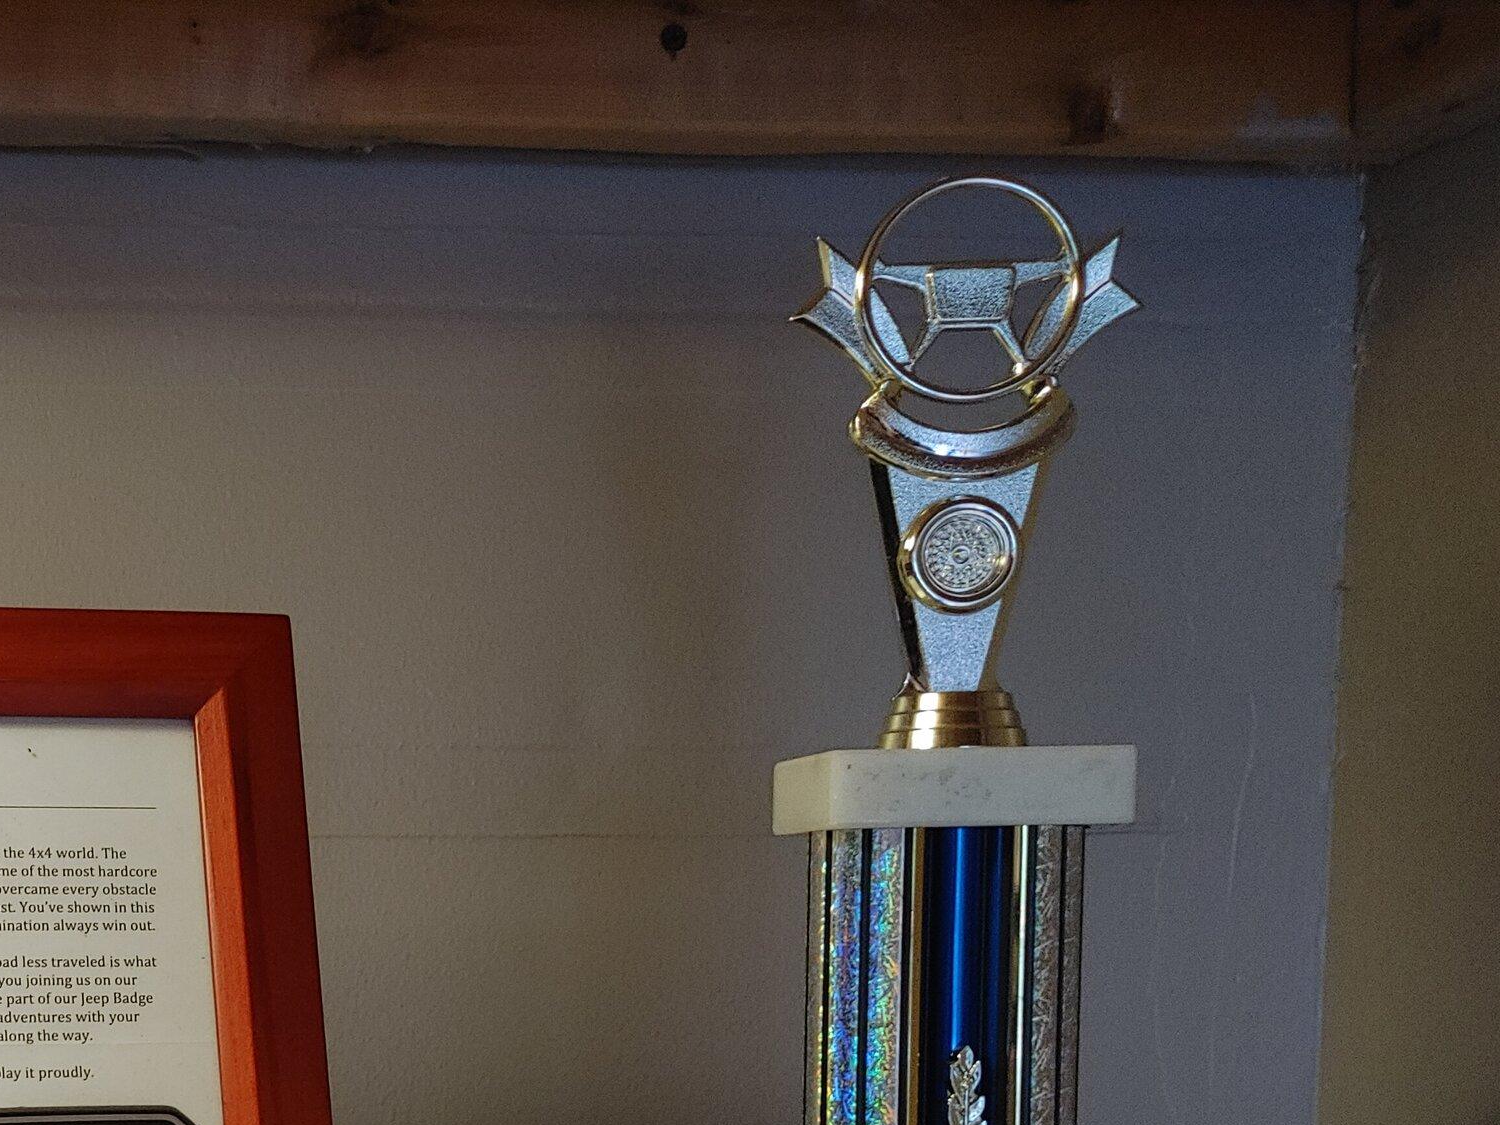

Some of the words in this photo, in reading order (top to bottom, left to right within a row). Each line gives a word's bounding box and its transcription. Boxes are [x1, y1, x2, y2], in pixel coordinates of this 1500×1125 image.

[2, 845, 25, 860] the
[27, 846, 53, 860] 4x4
[55, 846, 99, 860] world.
[100, 846, 127, 860] The
[52, 918, 100, 935] always
[101, 918, 128, 932] win
[129, 920, 156, 932] out.
[75, 1009, 106, 1023] with
[108, 1012, 141, 1026] your
